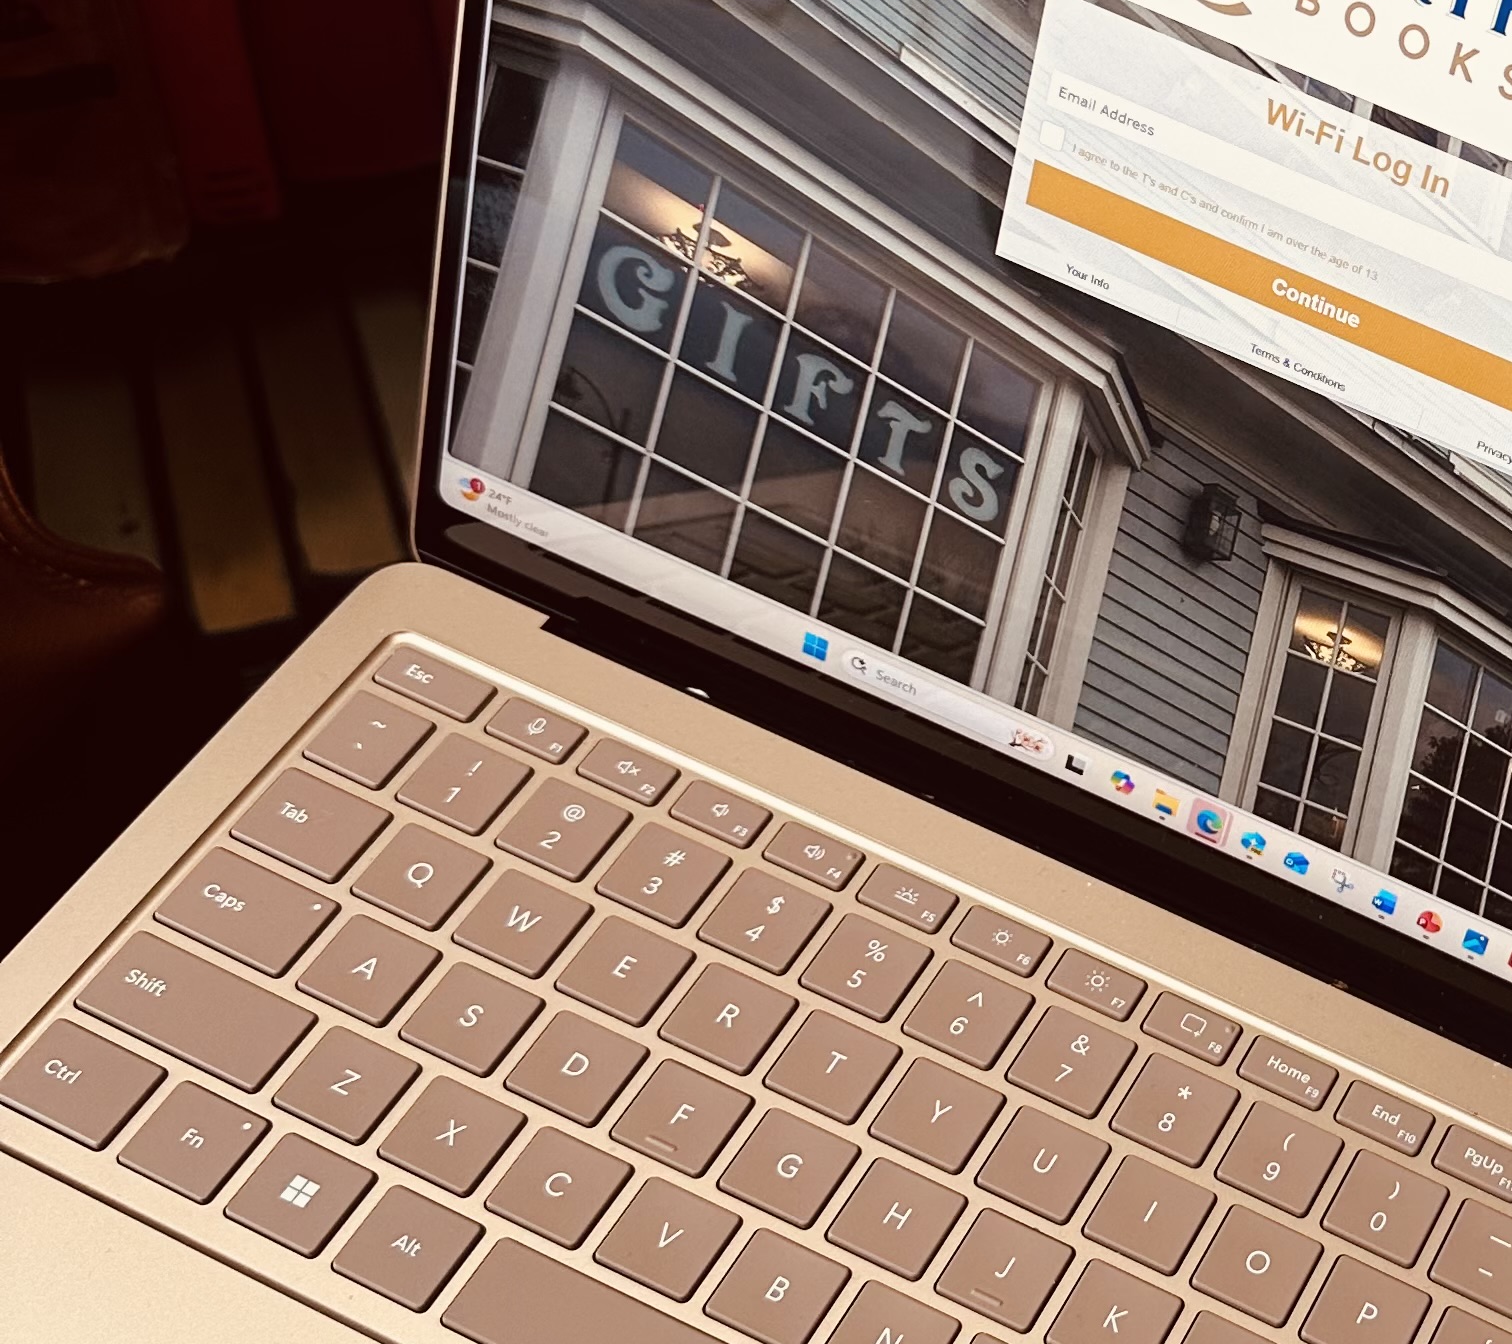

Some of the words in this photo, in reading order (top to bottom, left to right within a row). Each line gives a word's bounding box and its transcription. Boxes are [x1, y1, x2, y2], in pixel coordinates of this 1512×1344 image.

[1058, 86, 1096, 112] Email
[1100, 104, 1155, 137] Address
[1266, 98, 1346, 155] Wi-Fi
[1352, 137, 1413, 186] Log
[1421, 164, 1450, 197] In
[1078, 147, 1107, 167] agree
[1110, 160, 1120, 172] to
[1122, 163, 1139, 179] the
[1159, 180, 1178, 196] and
[1199, 198, 1219, 214] and
[1221, 206, 1259, 231] confirm
[1267, 226, 1283, 241] am
[1286, 235, 1308, 250] over
[1310, 242, 1328, 259] the
[1328, 254, 1349, 270] age
[1352, 260, 1363, 275] of
[1366, 266, 1378, 281] 13
[1066, 264, 1088, 282] Your
[1090, 274, 1110, 291] Info
[1271, 277, 1361, 328] Continue
[1250, 343, 1281, 366] Terms
[1294, 361, 1346, 392] Conditions
[597, 246, 1005, 522] GIFTS
[487, 503, 522, 527] Mostly
[406, 665, 433, 686] Esc
[875, 669, 916, 697] Search
[280, 801, 309, 824] Tab
[408, 862, 433, 887] Q
[203, 883, 246, 913] Caps
[505, 904, 542, 932] W
[351, 957, 378, 981] A
[612, 955, 638, 978] E
[125, 968, 167, 997] Shift
[459, 1004, 484, 1027] S
[716, 1003, 741, 1028] R
[44, 1059, 82, 1084] Ctrl
[561, 1052, 589, 1076] D
[824, 1050, 847, 1075] T
[1266, 1055, 1311, 1086] Home
[330, 1069, 361, 1095] Z
[669, 1103, 695, 1125] F
[931, 1100, 953, 1123] Y
[1371, 1104, 1401, 1126] End
[181, 1128, 204, 1148] Fn
[435, 1119, 467, 1145] X
[776, 1154, 803, 1178] G
[1033, 1148, 1058, 1173] U
[1464, 1147, 1504, 1176] PgUp
[545, 1172, 572, 1197] C
[883, 1201, 913, 1230] H
[391, 1235, 422, 1257] Alt
[658, 1221, 684, 1248] V
[1244, 1250, 1271, 1274] O
[765, 1276, 790, 1302] B
[1103, 1305, 1129, 1333] K
[1356, 1301, 1378, 1324] P
